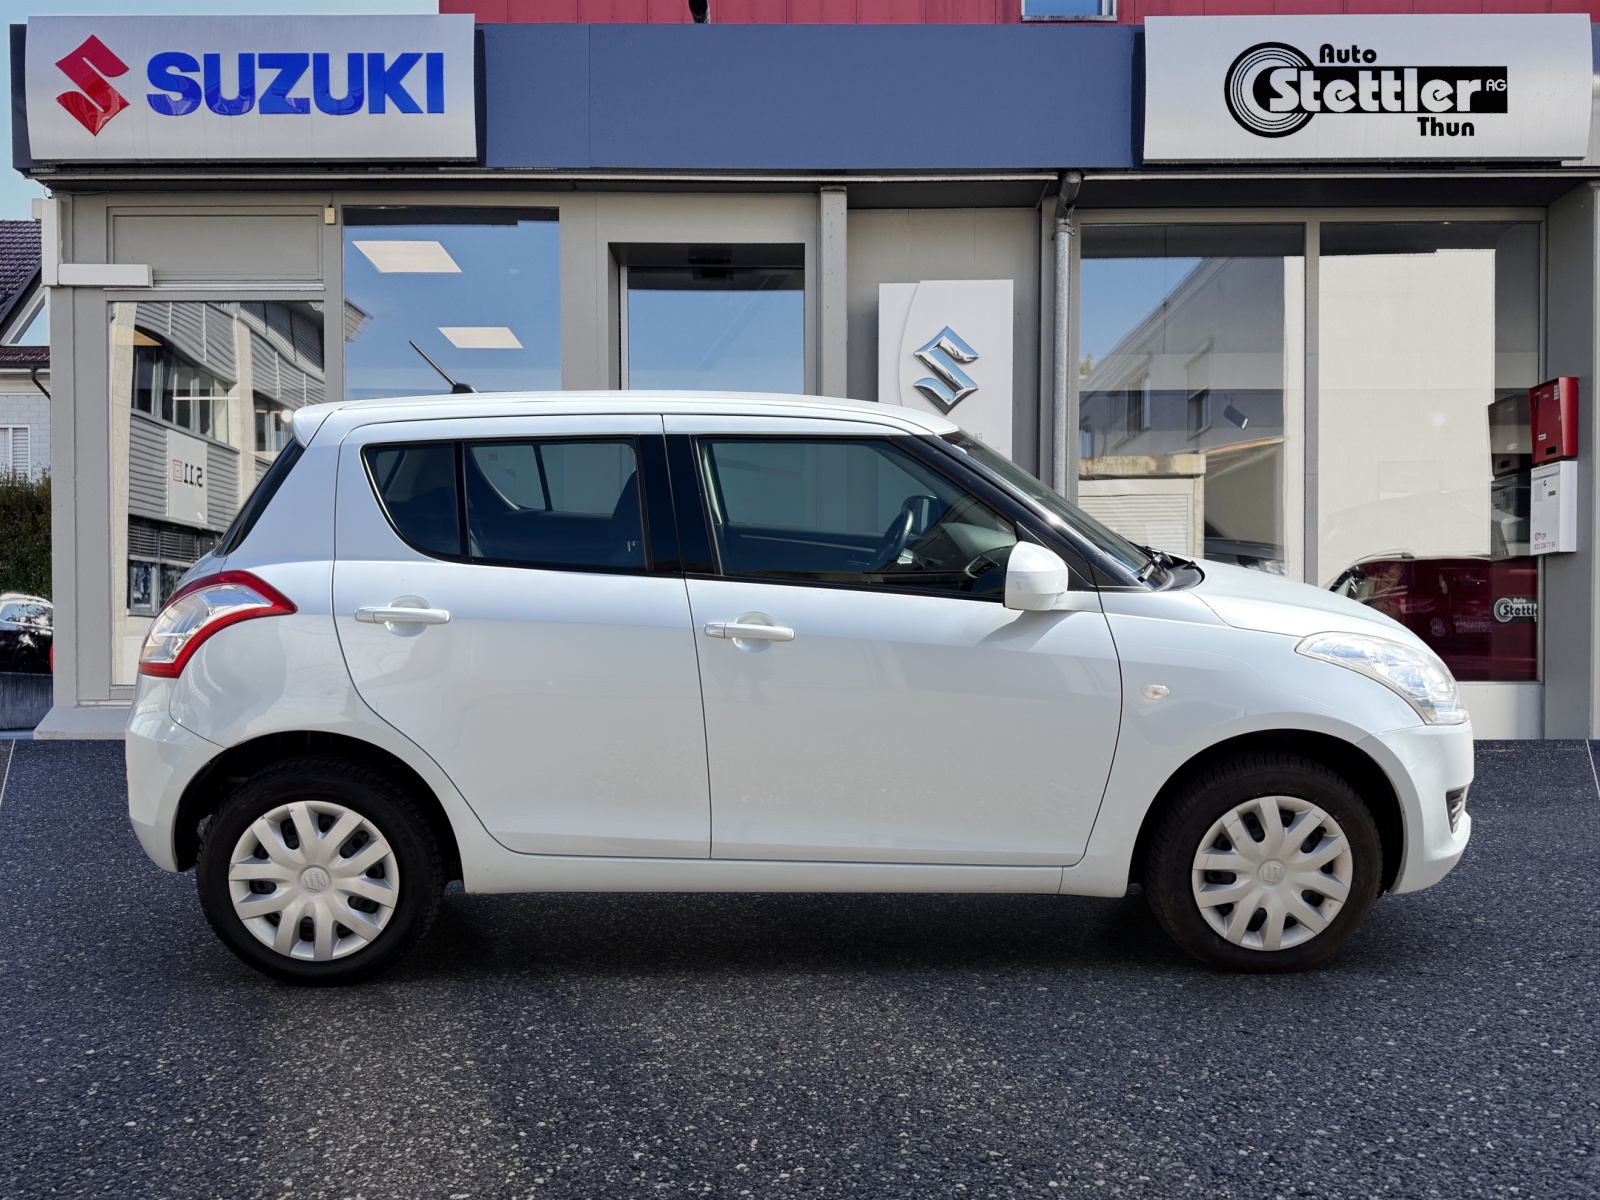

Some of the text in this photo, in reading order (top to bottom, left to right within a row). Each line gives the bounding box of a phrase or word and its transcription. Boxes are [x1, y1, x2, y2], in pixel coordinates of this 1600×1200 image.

[1320, 43, 1377, 64] Auto
[147, 52, 444, 115] SUZUKI
[1269, 68, 1507, 113] Stettler AG
[1417, 117, 1475, 137] Thun
